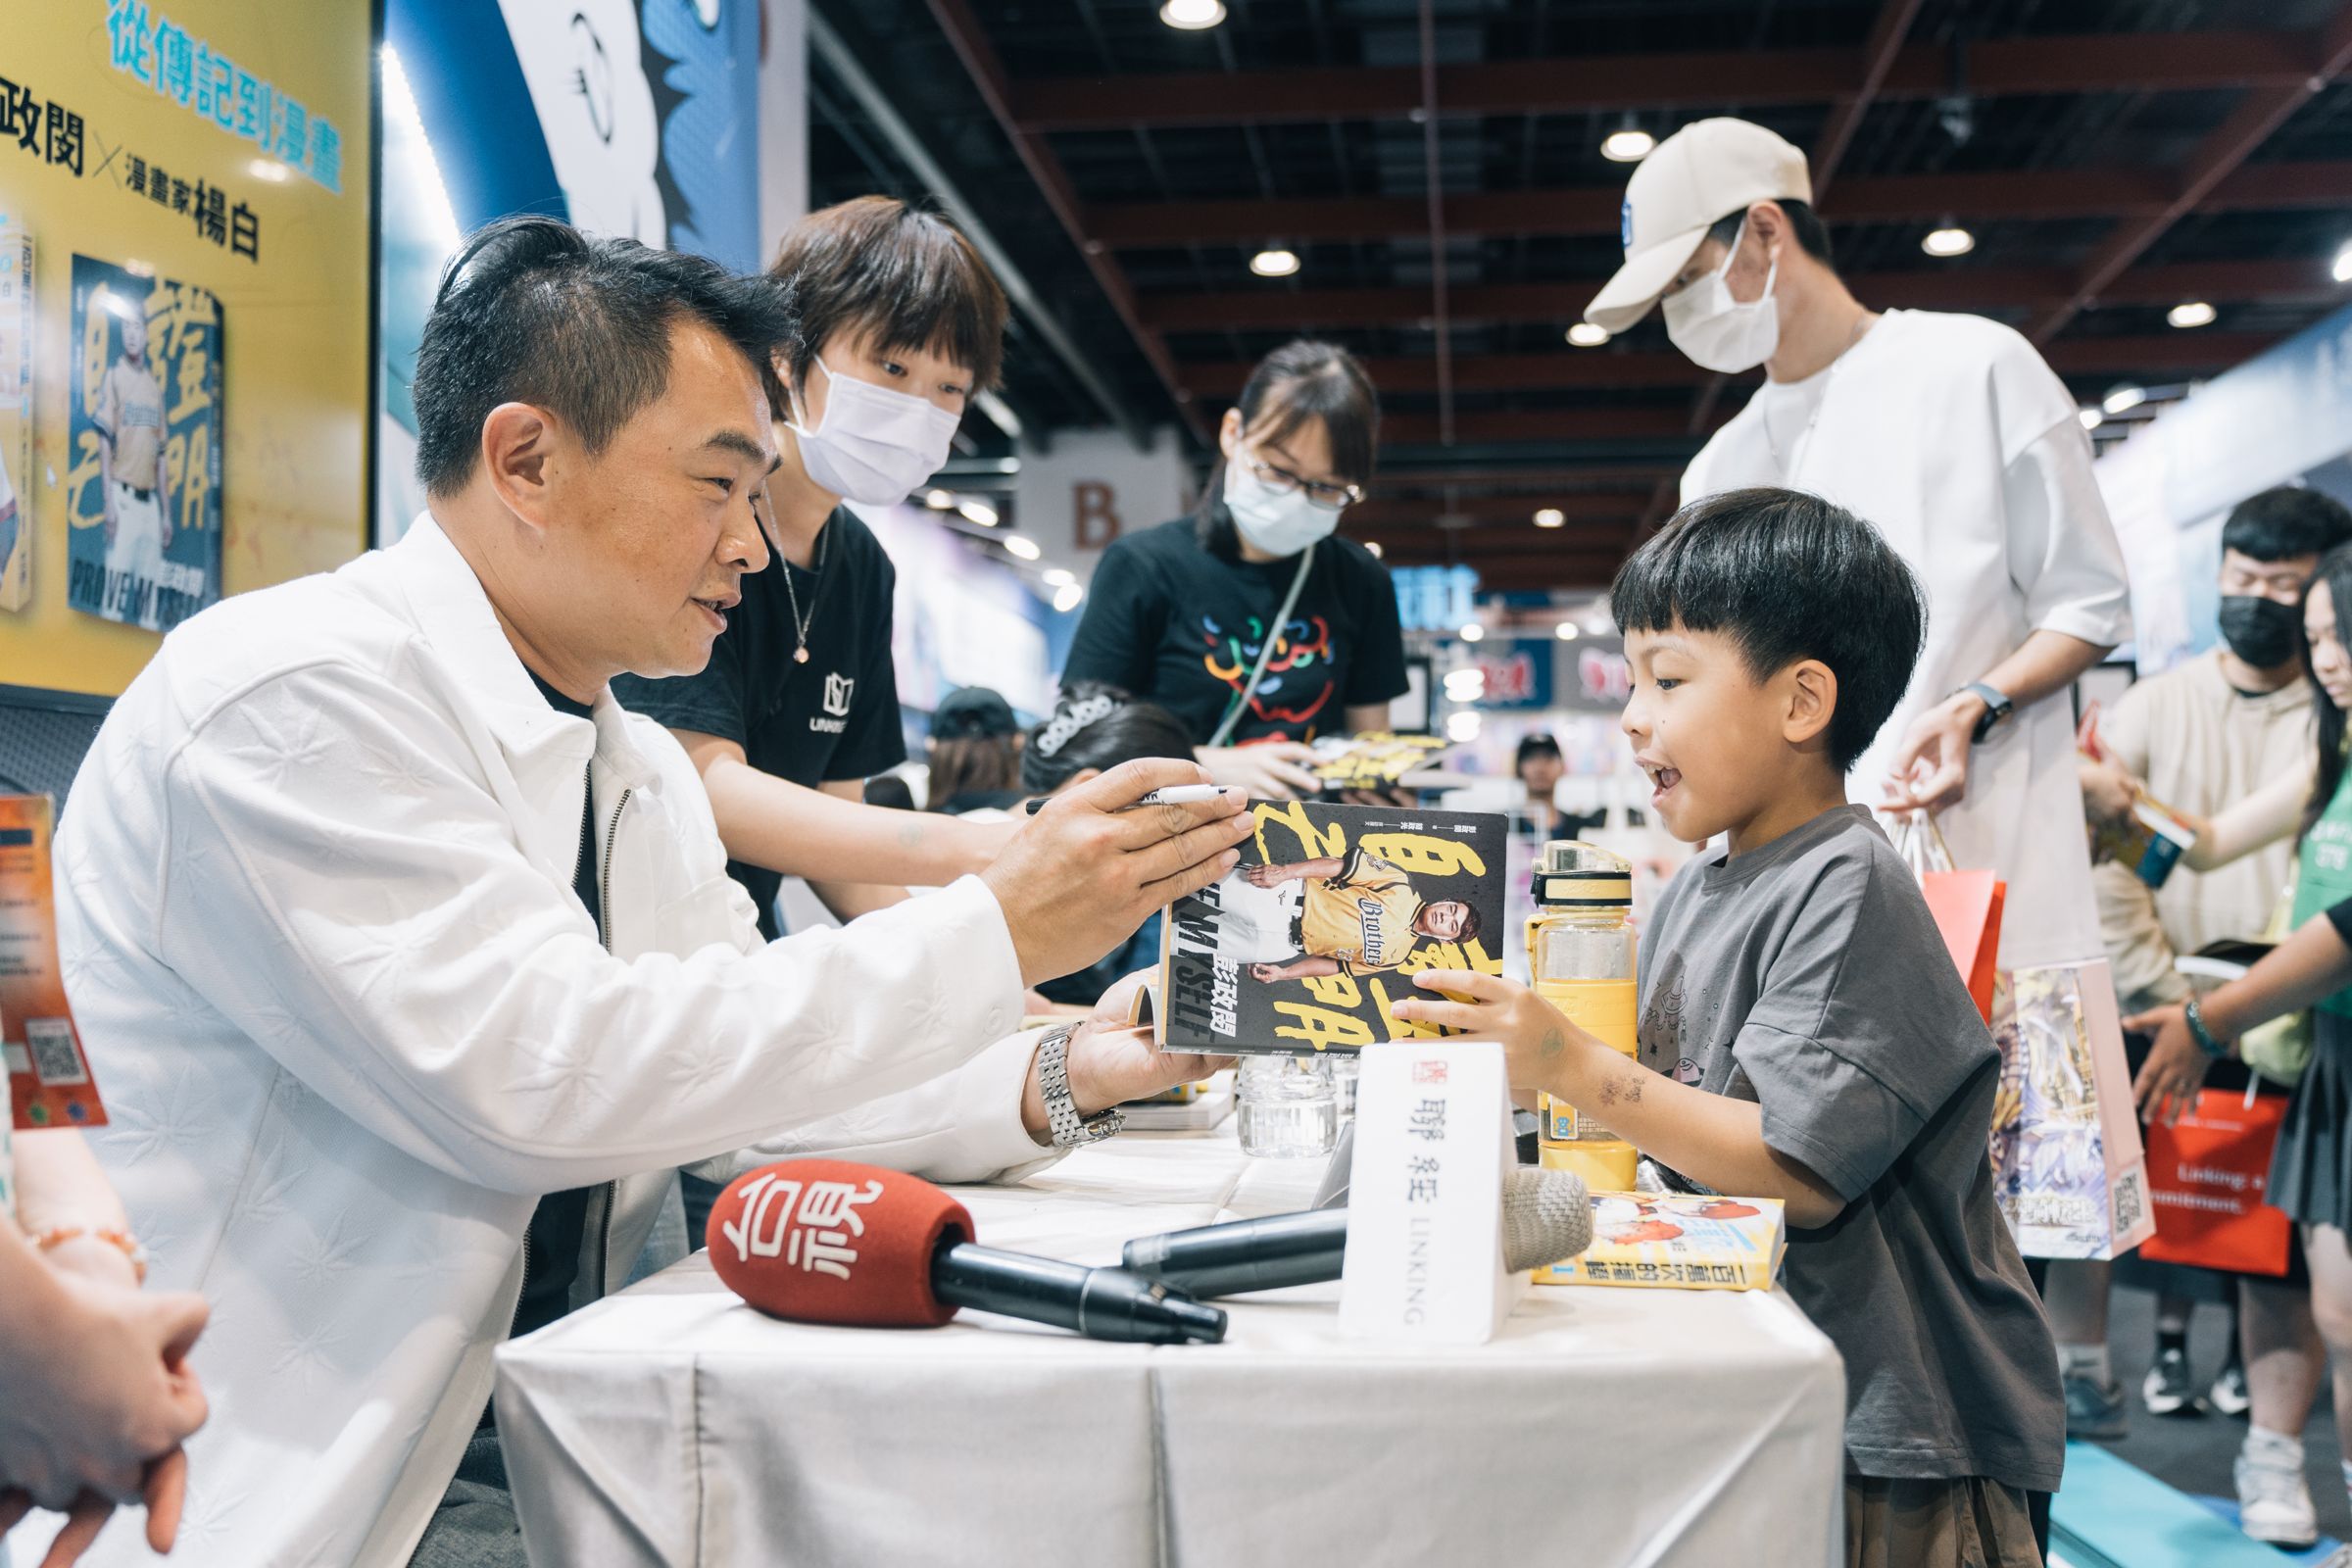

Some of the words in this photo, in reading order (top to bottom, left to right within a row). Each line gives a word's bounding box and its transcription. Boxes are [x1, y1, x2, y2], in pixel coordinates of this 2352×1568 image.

[105, 0, 341, 195] 從傳記到漫畫
[1071, 480, 1121, 550] B
[1357, 897, 1386, 965] Brothers
[1209, 952, 1240, 1038] 彭政閔
[722, 1172, 884, 1281] 台視
[1403, 1216, 1431, 1326] LINKING
